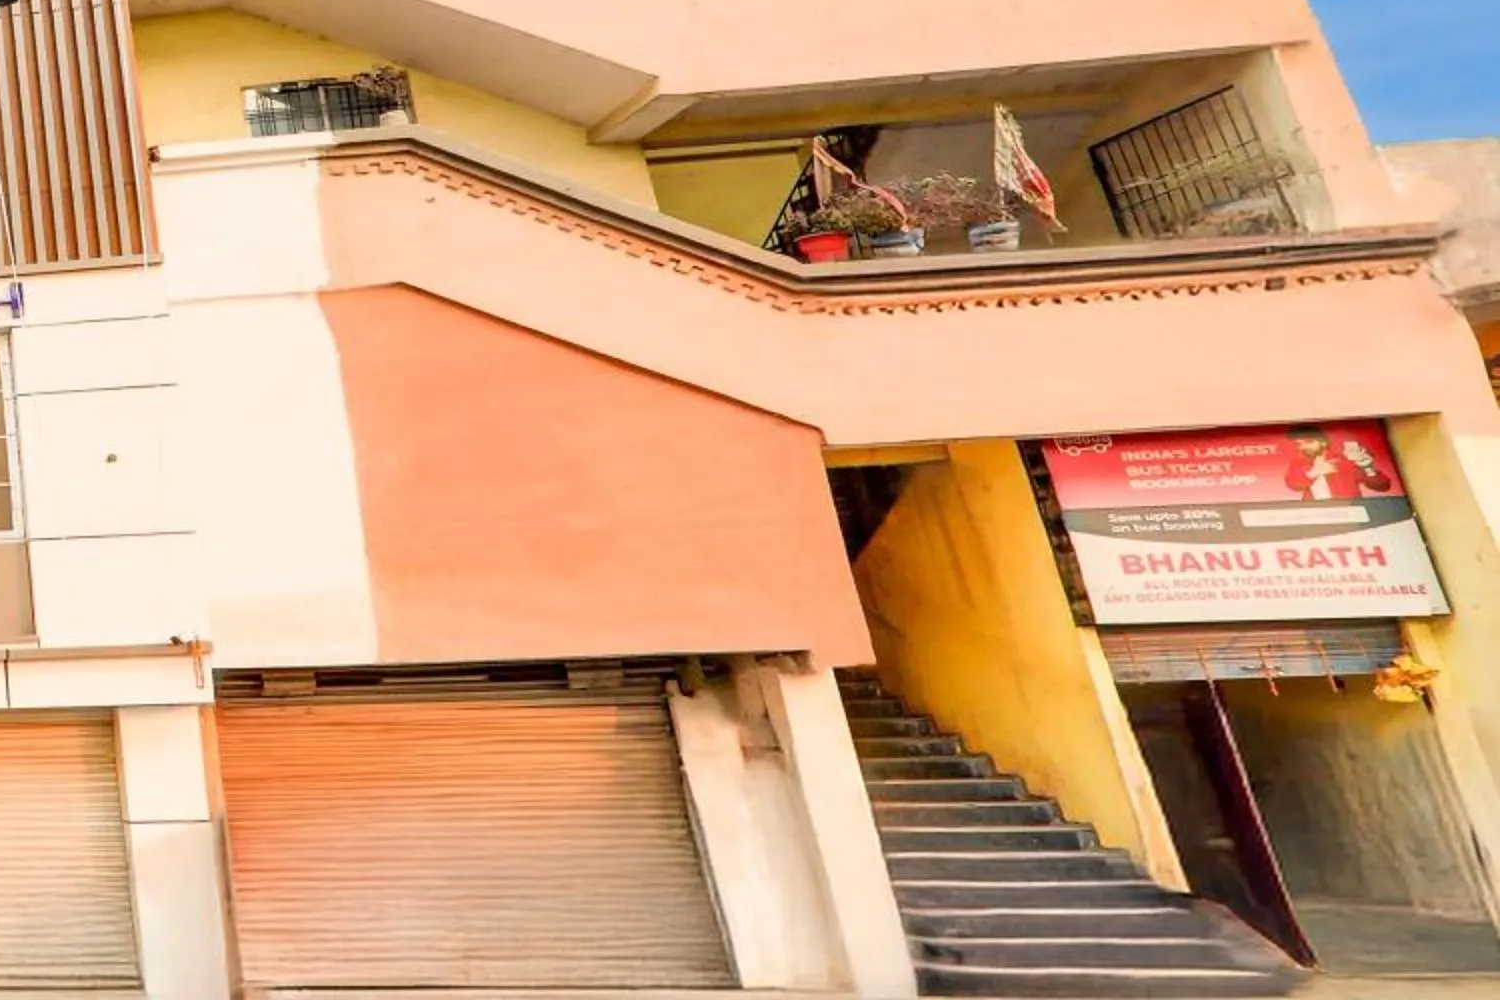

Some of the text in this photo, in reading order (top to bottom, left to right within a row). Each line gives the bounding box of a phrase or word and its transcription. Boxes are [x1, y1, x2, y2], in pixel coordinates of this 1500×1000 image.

[1121, 443, 1279, 462] INDIA'S LARGEST
[1168, 461, 1234, 474] TICKET
[1163, 520, 1225, 532] booking
[1118, 545, 1388, 576] BHANU RATH
